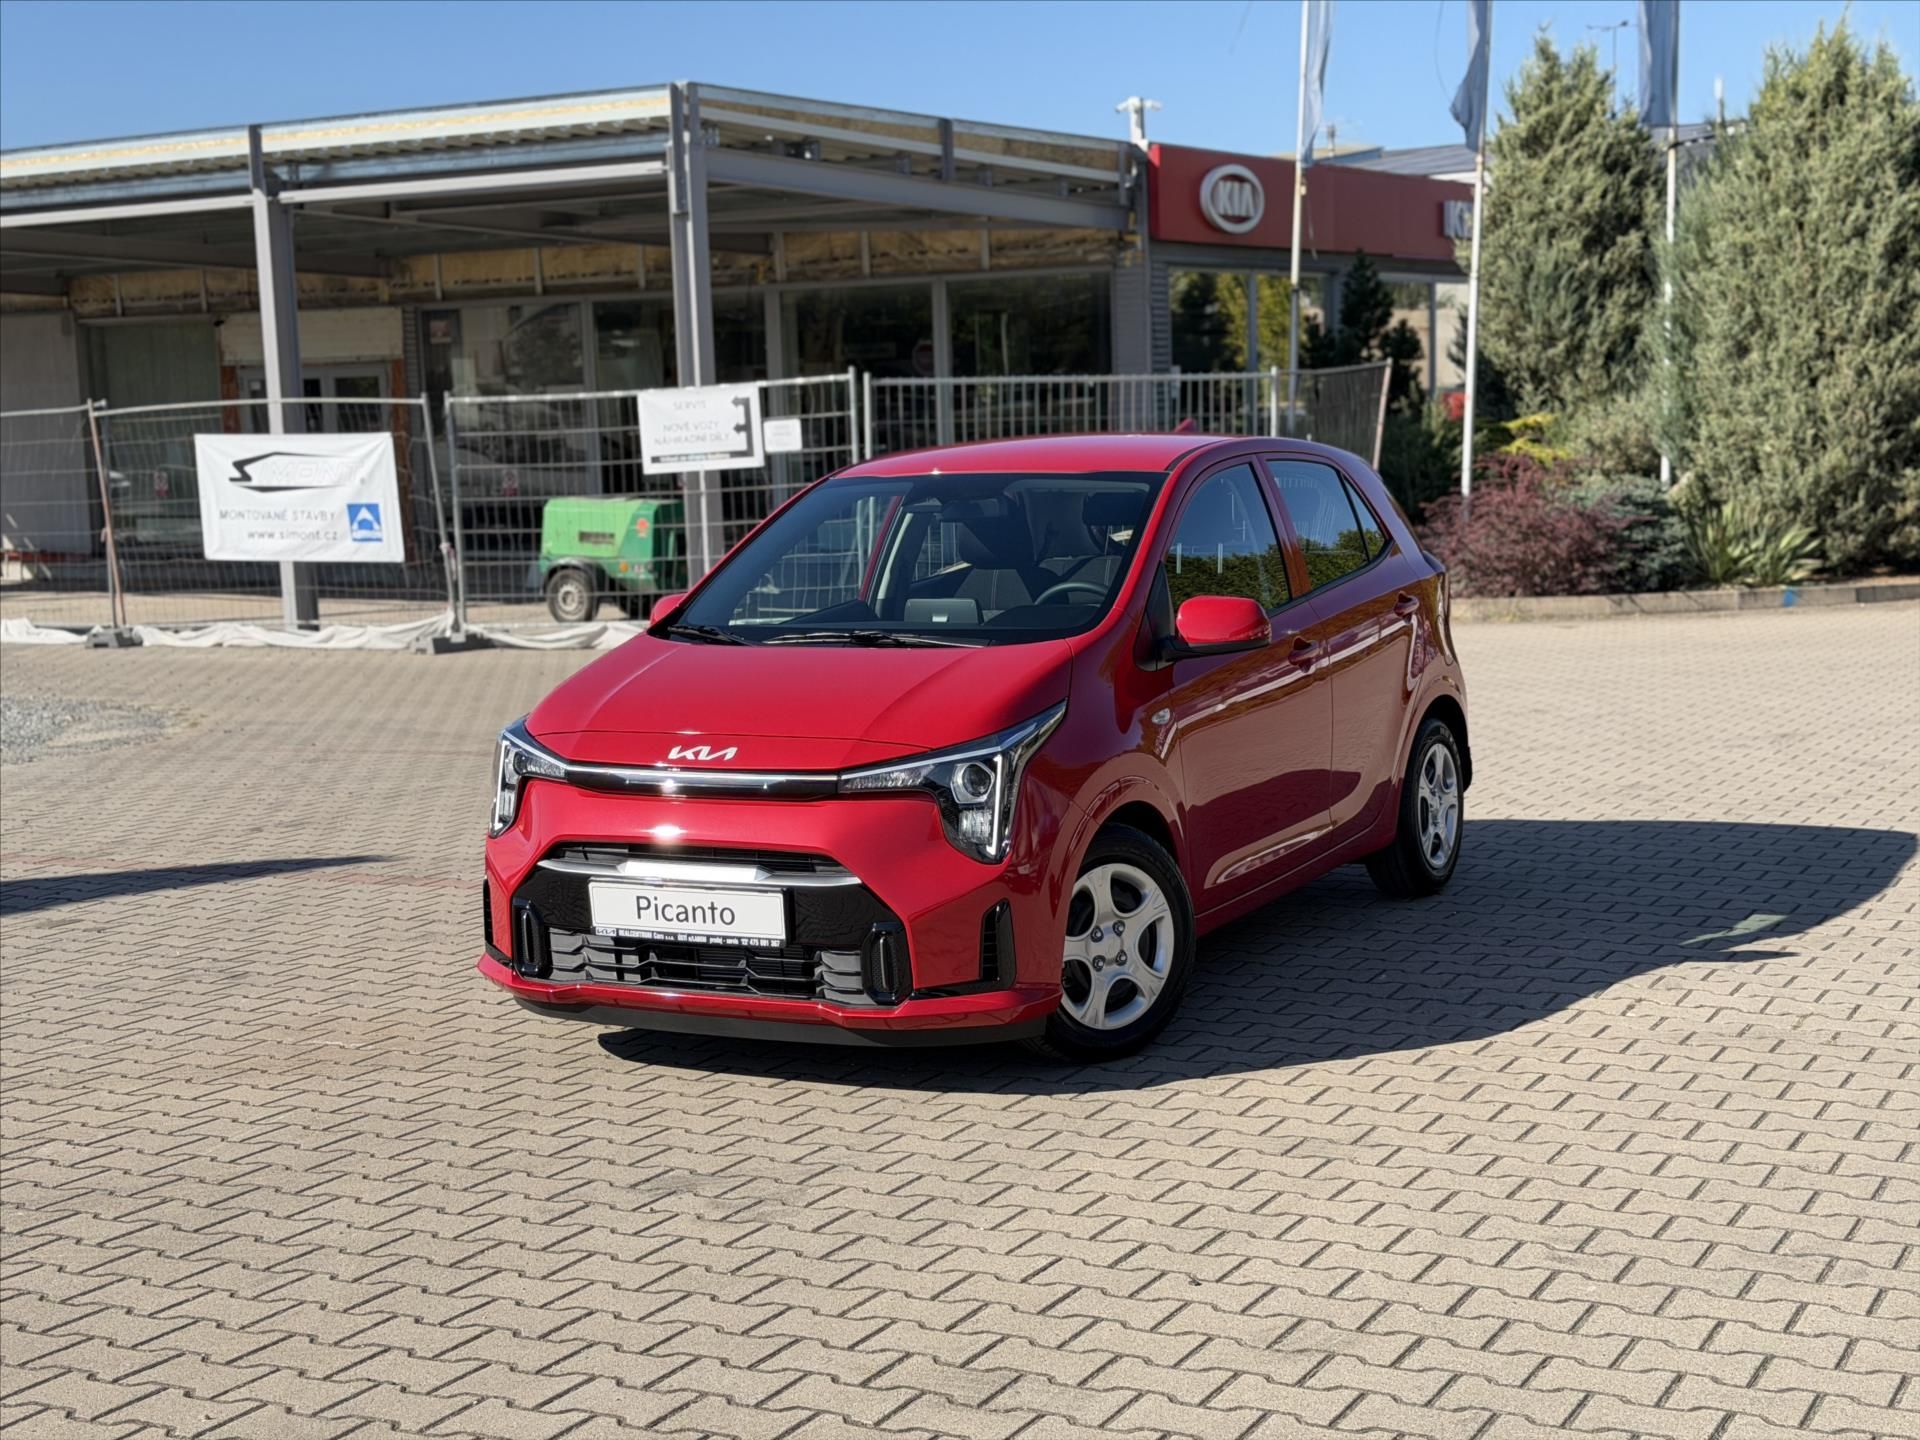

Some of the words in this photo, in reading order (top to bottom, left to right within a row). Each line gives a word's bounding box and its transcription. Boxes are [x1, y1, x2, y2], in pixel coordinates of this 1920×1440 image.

[219, 508, 288, 521] MONTOVANÉ
[292, 510, 336, 521] STAVBY
[248, 529, 338, 541] www.simont.cz
[668, 745, 738, 760] KIA
[636, 895, 735, 926] Picanto
